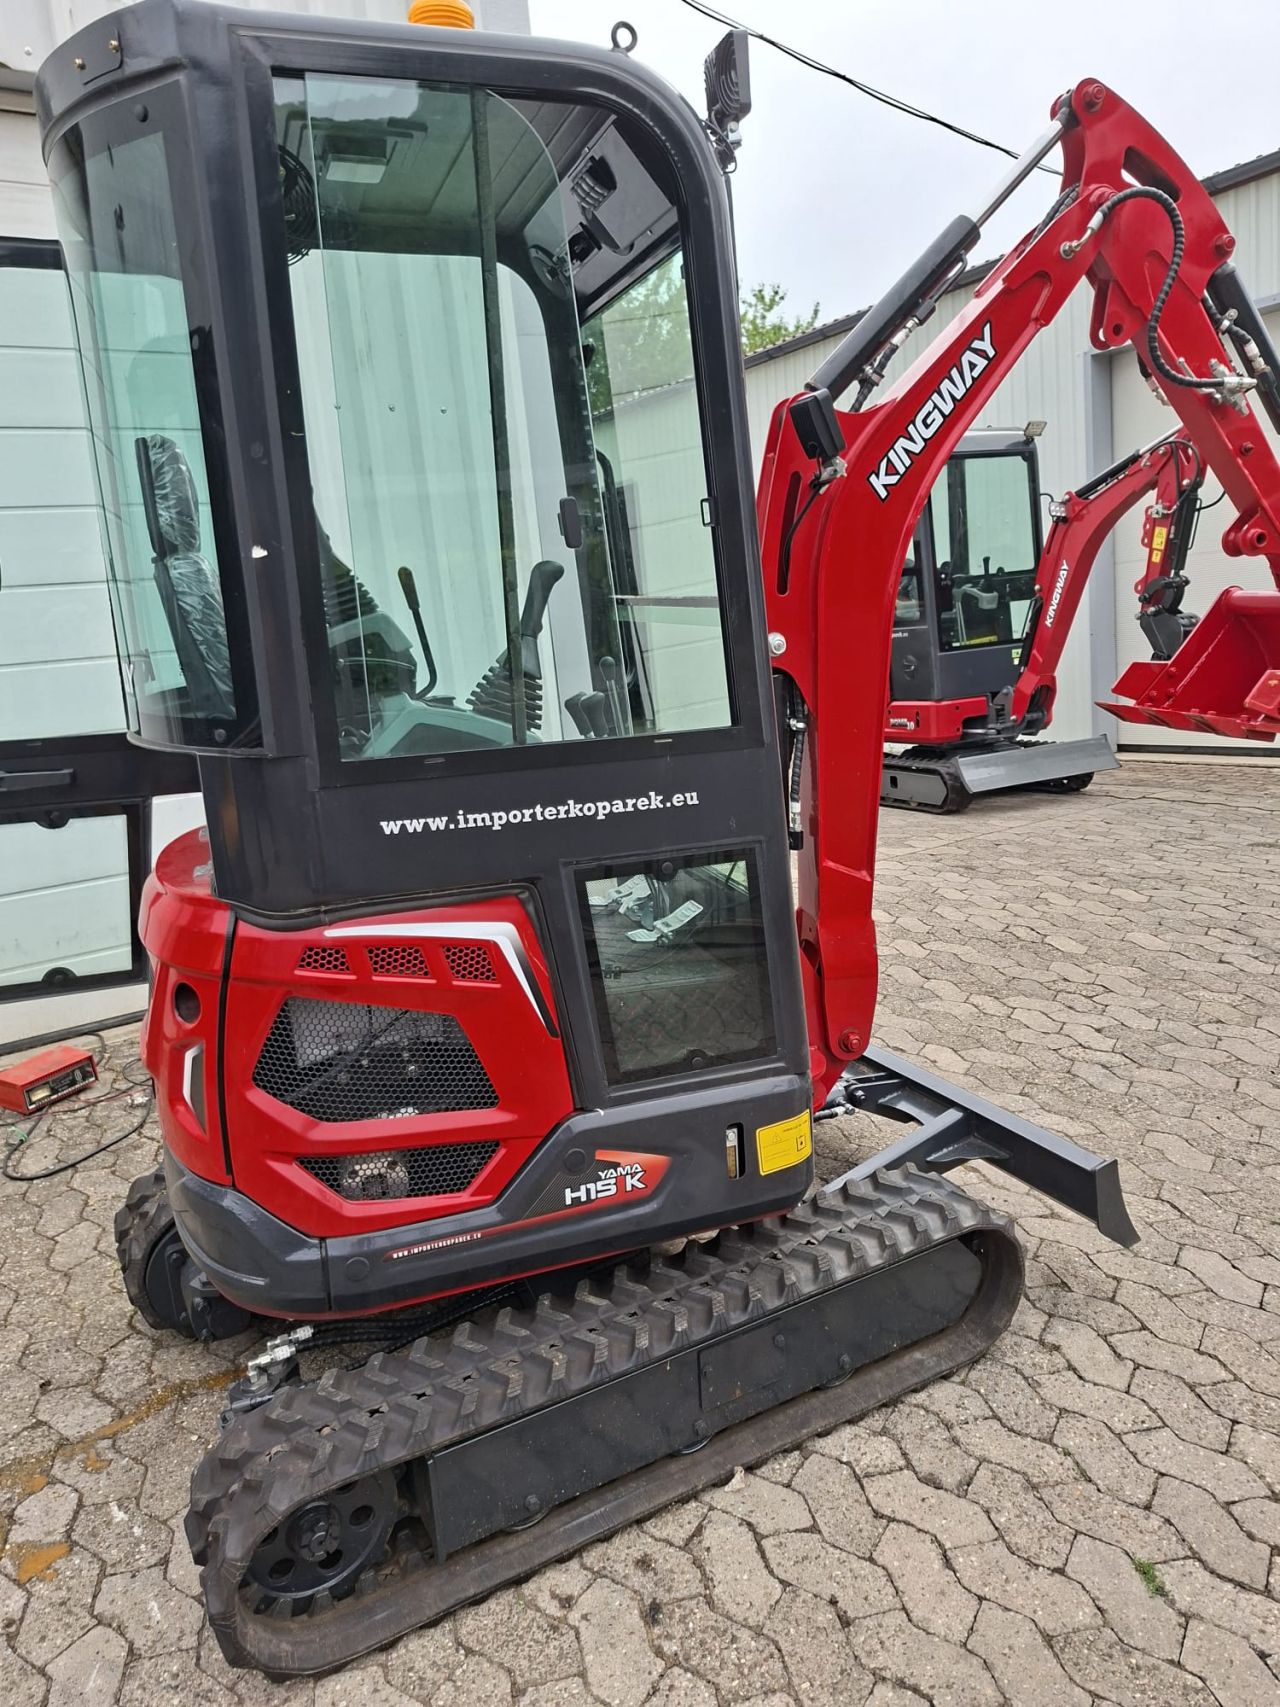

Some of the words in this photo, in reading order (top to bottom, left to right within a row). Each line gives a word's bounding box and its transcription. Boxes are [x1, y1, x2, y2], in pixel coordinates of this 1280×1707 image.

[868, 321, 996, 501] KINGWAY
[1045, 559, 1069, 628] KINGWAY
[379, 791, 700, 835] www.importerkoparek.eu
[565, 1178, 617, 1206] H15
[625, 1171, 646, 1192] K
[598, 1163, 643, 1180] YAMA
